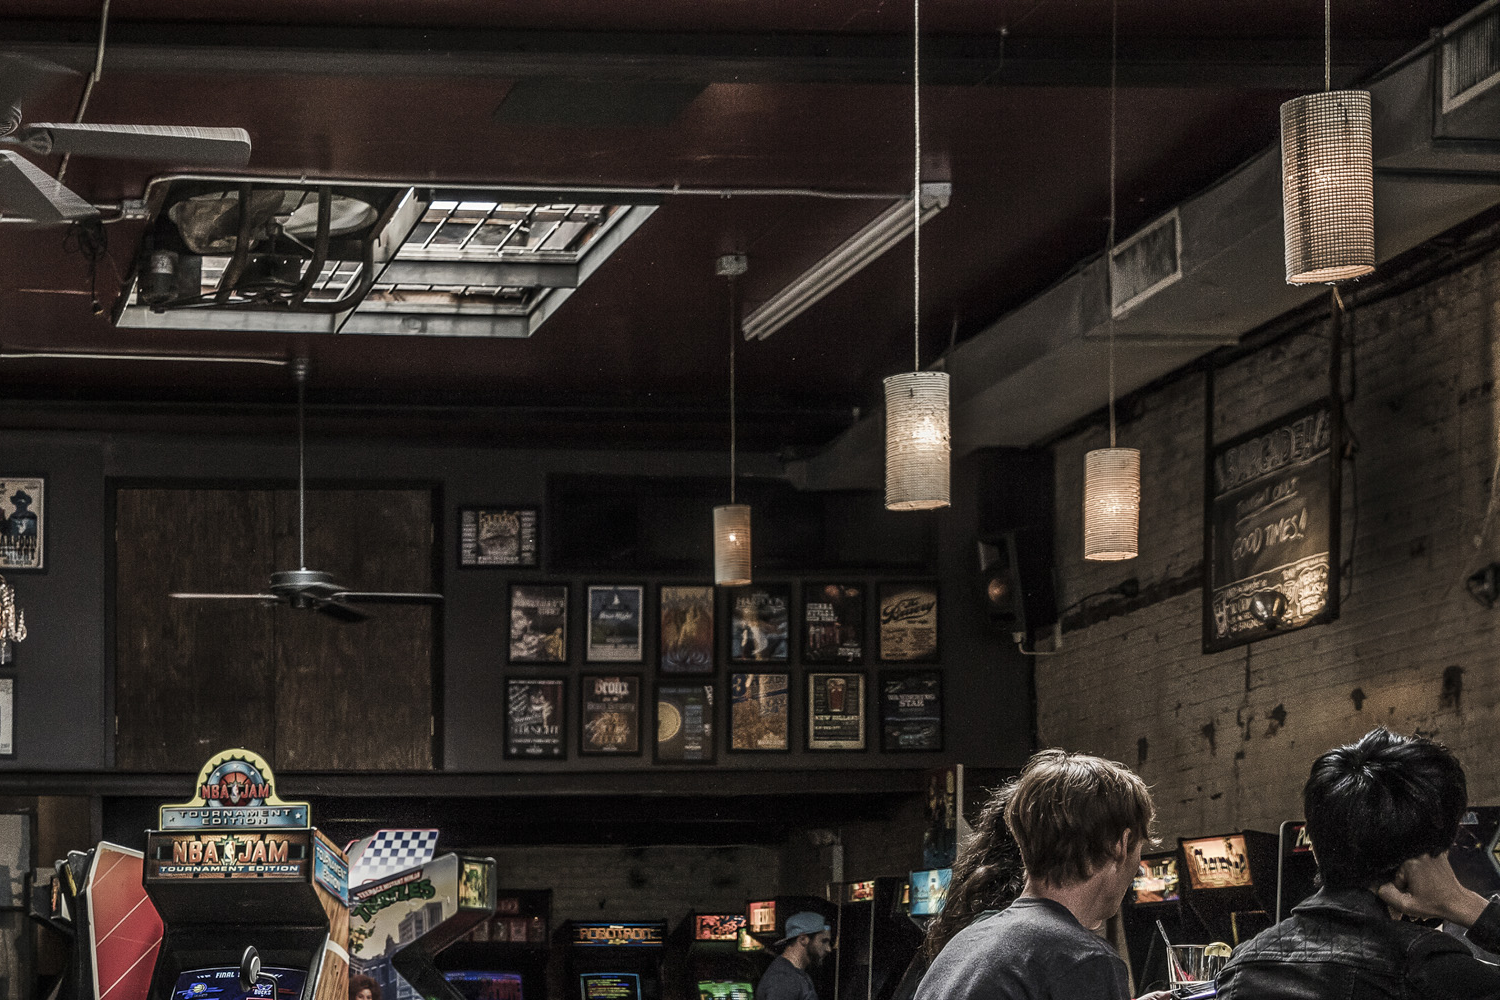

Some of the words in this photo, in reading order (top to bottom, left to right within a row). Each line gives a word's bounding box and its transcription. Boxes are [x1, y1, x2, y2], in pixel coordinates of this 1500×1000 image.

[1232, 526, 1262, 560] GOOD
[1265, 507, 1307, 542] TIMES!
[201, 784, 229, 799] NBA
[241, 783, 270, 799] JAM
[179, 809, 291, 818] TOURNAMENT
[173, 841, 219, 863] NBA
[239, 841, 289, 863] JAM
[351, 878, 436, 922] TURTLES
